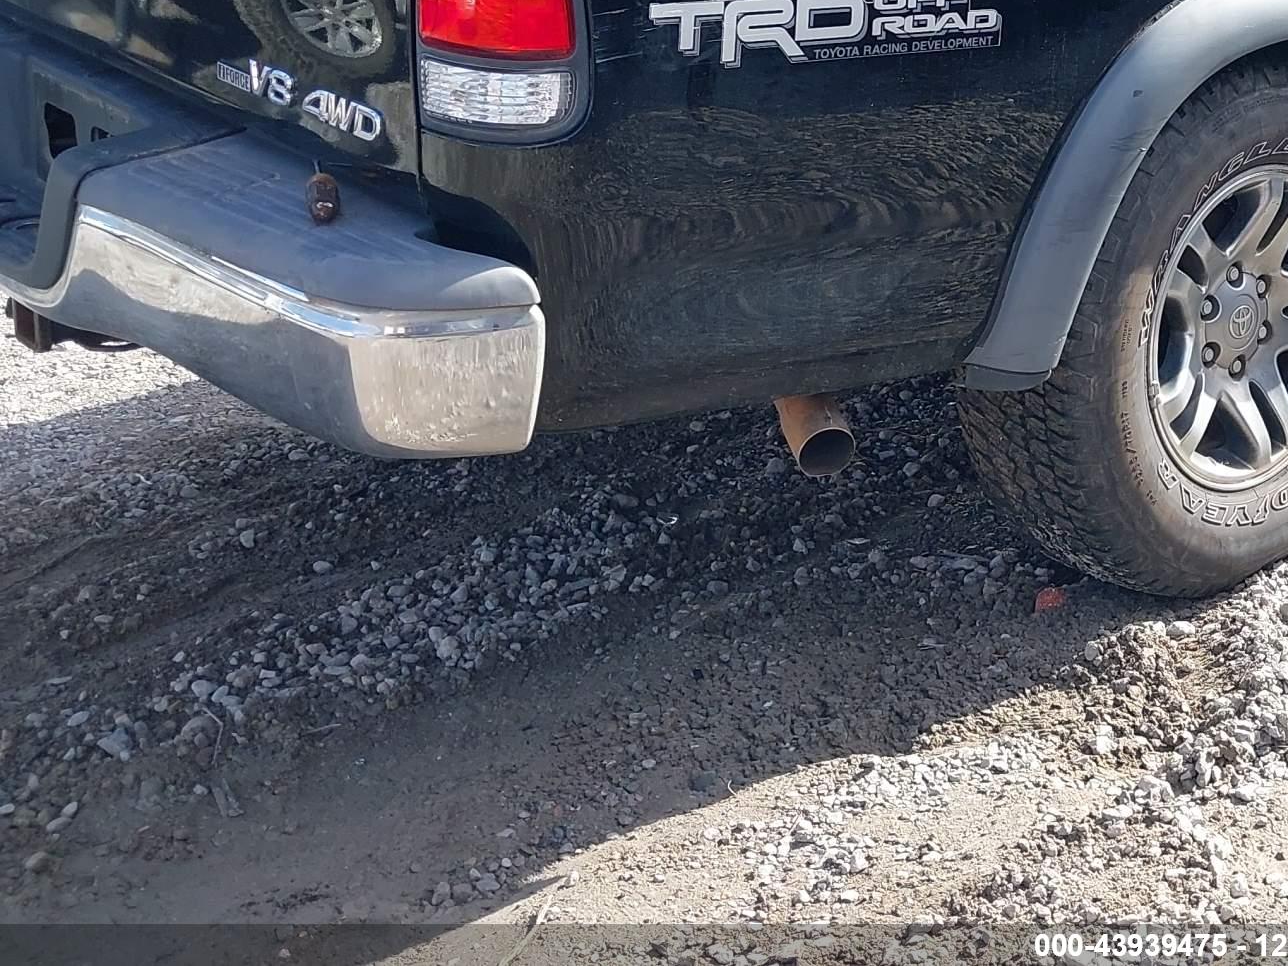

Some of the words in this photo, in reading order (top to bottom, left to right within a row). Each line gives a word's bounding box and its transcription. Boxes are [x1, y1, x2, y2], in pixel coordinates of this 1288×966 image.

[872, 9, 1001, 40] ROAD
[814, 46, 860, 60] TOYOTA
[863, 42, 908, 56] RACING
[912, 36, 994, 52] DEVELOPMENT
[249, 59, 294, 106] V8
[302, 90, 381, 142] 4WD
